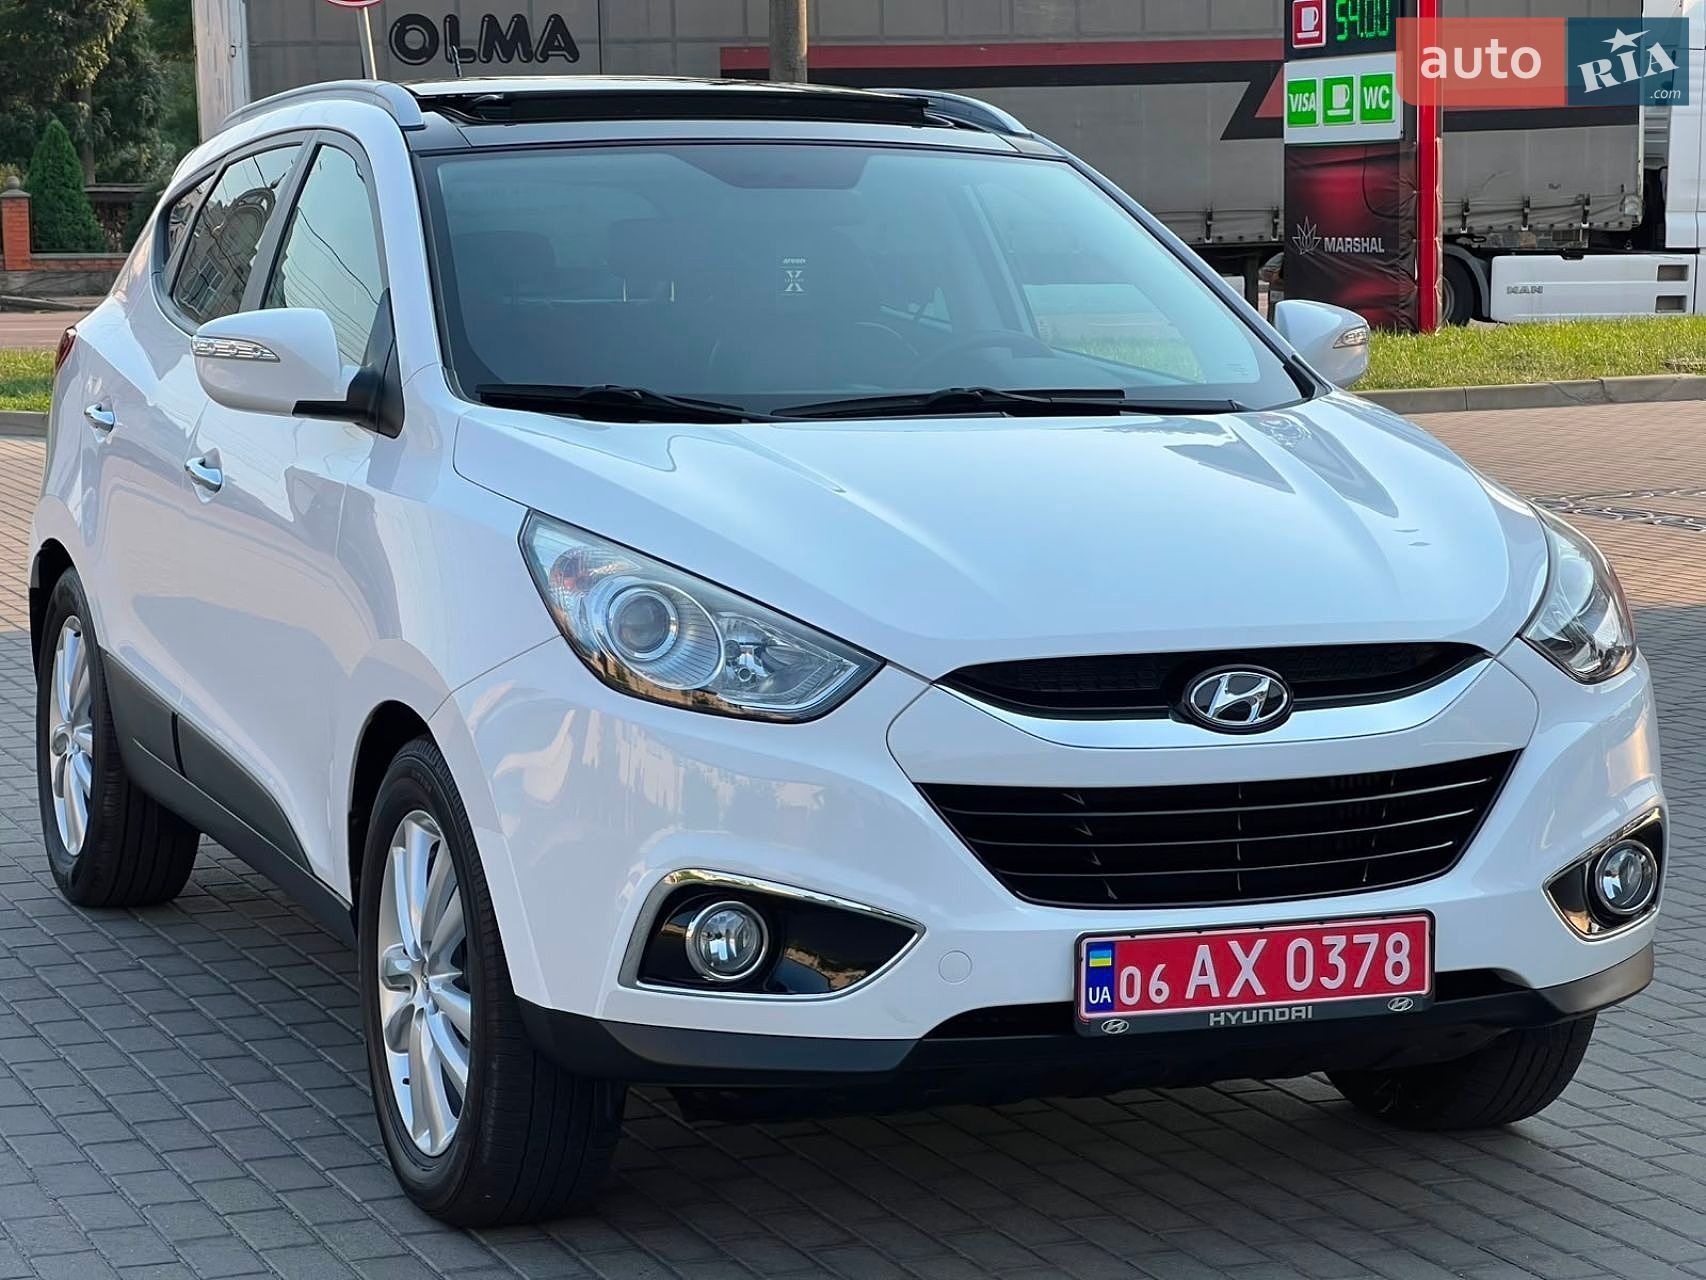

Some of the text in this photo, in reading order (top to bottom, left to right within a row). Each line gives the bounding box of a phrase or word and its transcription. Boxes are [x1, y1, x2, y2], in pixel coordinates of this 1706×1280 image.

[389, 13, 580, 66] OLMA
[1288, 92, 1316, 112] VISA
[1363, 85, 1391, 110] WC
[1324, 237, 1385, 253] MARSHAL
[1119, 932, 1411, 1006] 06 AX 0378
[1089, 986, 1112, 1004] UA
[1209, 1006, 1312, 1026] HYUNDAI
